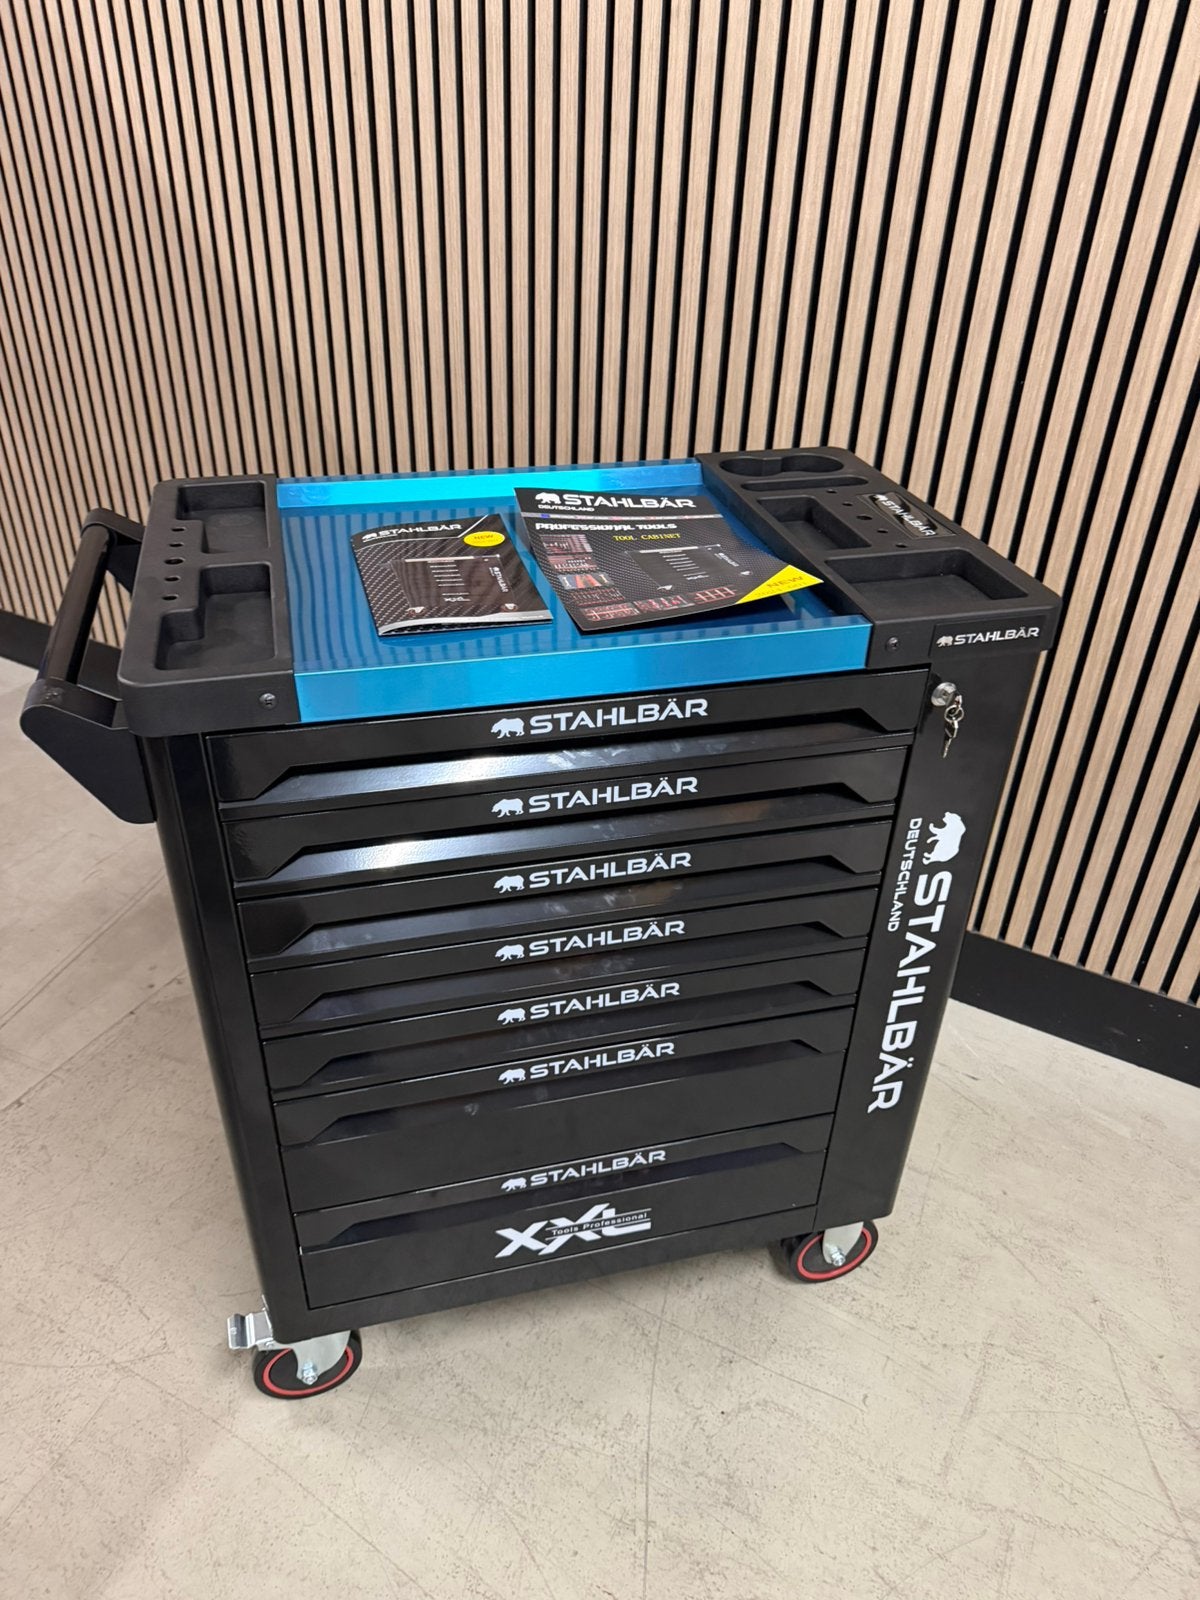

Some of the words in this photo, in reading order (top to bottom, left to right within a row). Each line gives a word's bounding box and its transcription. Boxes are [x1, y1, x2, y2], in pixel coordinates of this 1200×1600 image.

[562, 493, 696, 508] STAHLBÄR
[881, 499, 937, 537] STAHLBÄR
[953, 626, 1040, 646] STAHLBÄR
[529, 698, 709, 735] STAHLBÄR
[529, 776, 698, 813] STAHLBÄR
[529, 852, 692, 889] STAHLBÄR
[887, 817, 923, 932] DEUTSCHLAND
[529, 920, 685, 957] STAHLBÄR
[530, 982, 680, 1020] STAHLBÄR
[867, 870, 953, 1114] STAHLBÄR
[530, 1042, 675, 1079] STAHLBÄR
[530, 1150, 666, 1187] STAHLBÄR
[552, 1226, 579, 1236] Tools
[583, 1212, 648, 1230] Professional
